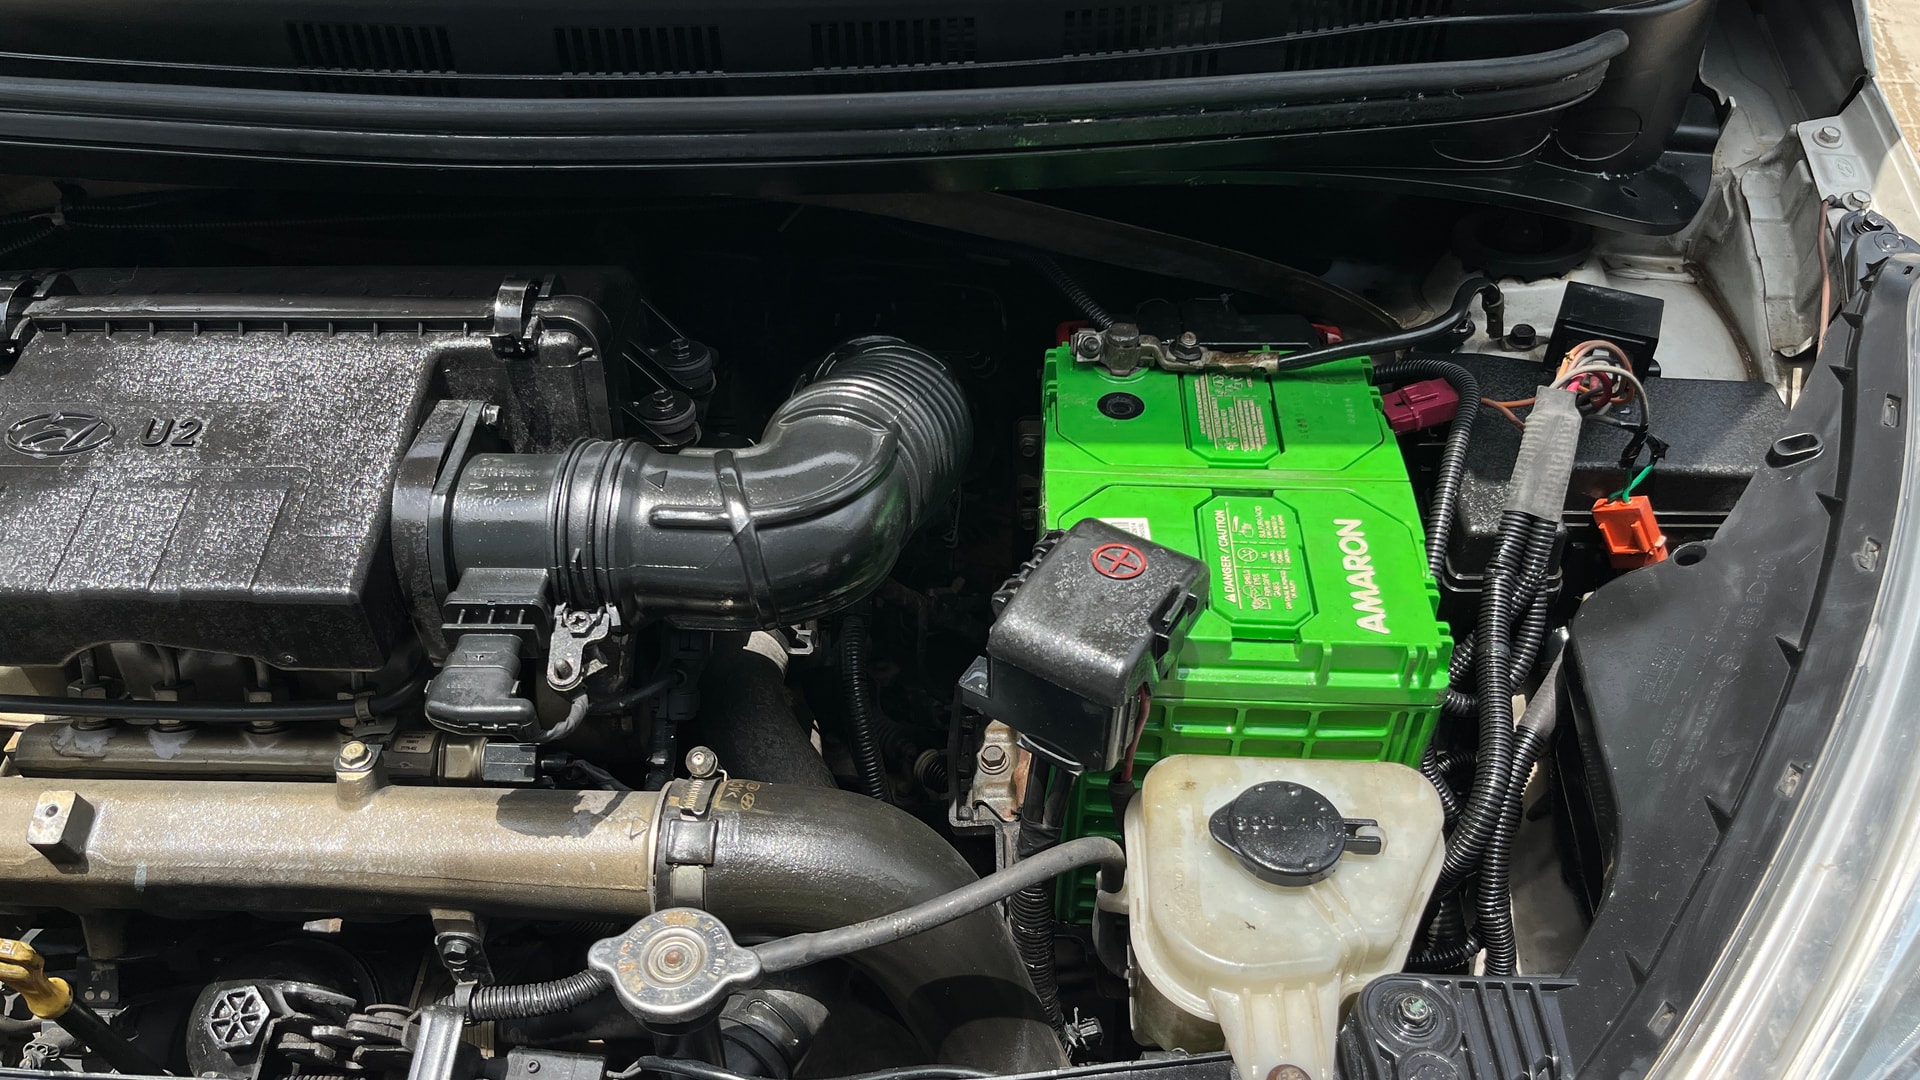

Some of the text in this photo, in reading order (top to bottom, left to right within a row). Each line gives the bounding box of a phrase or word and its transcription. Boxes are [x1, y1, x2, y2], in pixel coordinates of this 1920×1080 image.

[139, 418, 203, 448] U2
[1215, 510, 1228, 546] CAUTION
[1221, 556, 1234, 592] DANGER
[1333, 519, 1391, 634] AMARON
